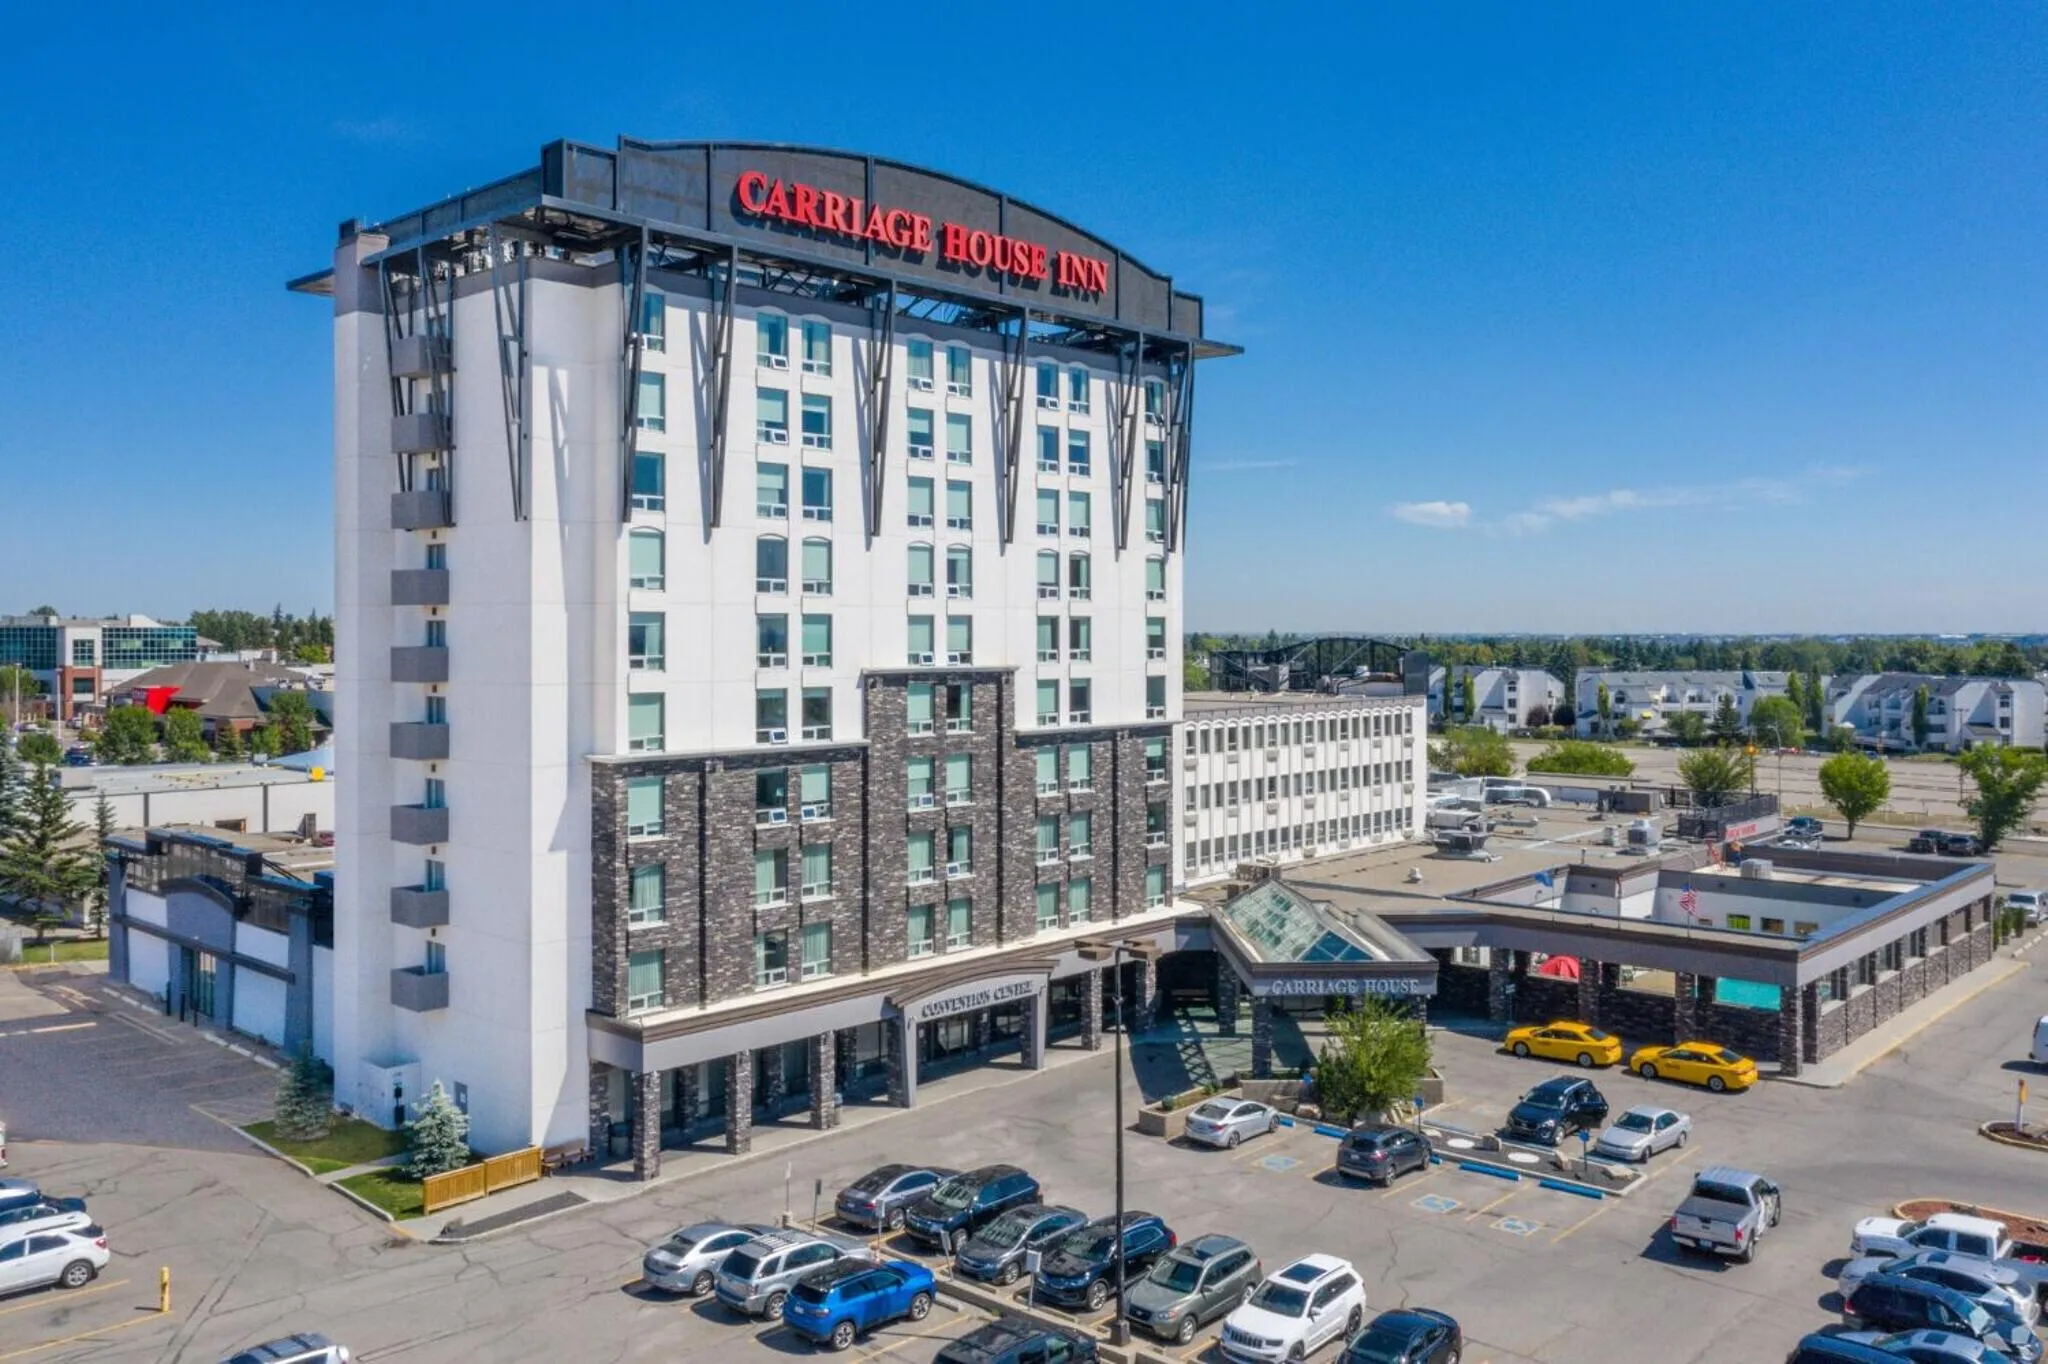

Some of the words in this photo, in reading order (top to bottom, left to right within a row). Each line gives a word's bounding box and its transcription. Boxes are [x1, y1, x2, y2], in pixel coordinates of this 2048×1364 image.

[736, 170, 933, 252] CARRIAGE
[942, 222, 1048, 280] HOUSE
[1056, 251, 1109, 294] INN
[1271, 979, 1358, 996] CARRIAGE
[1364, 979, 1420, 995] HOUSE
[921, 989, 990, 1017] CONVENTION
